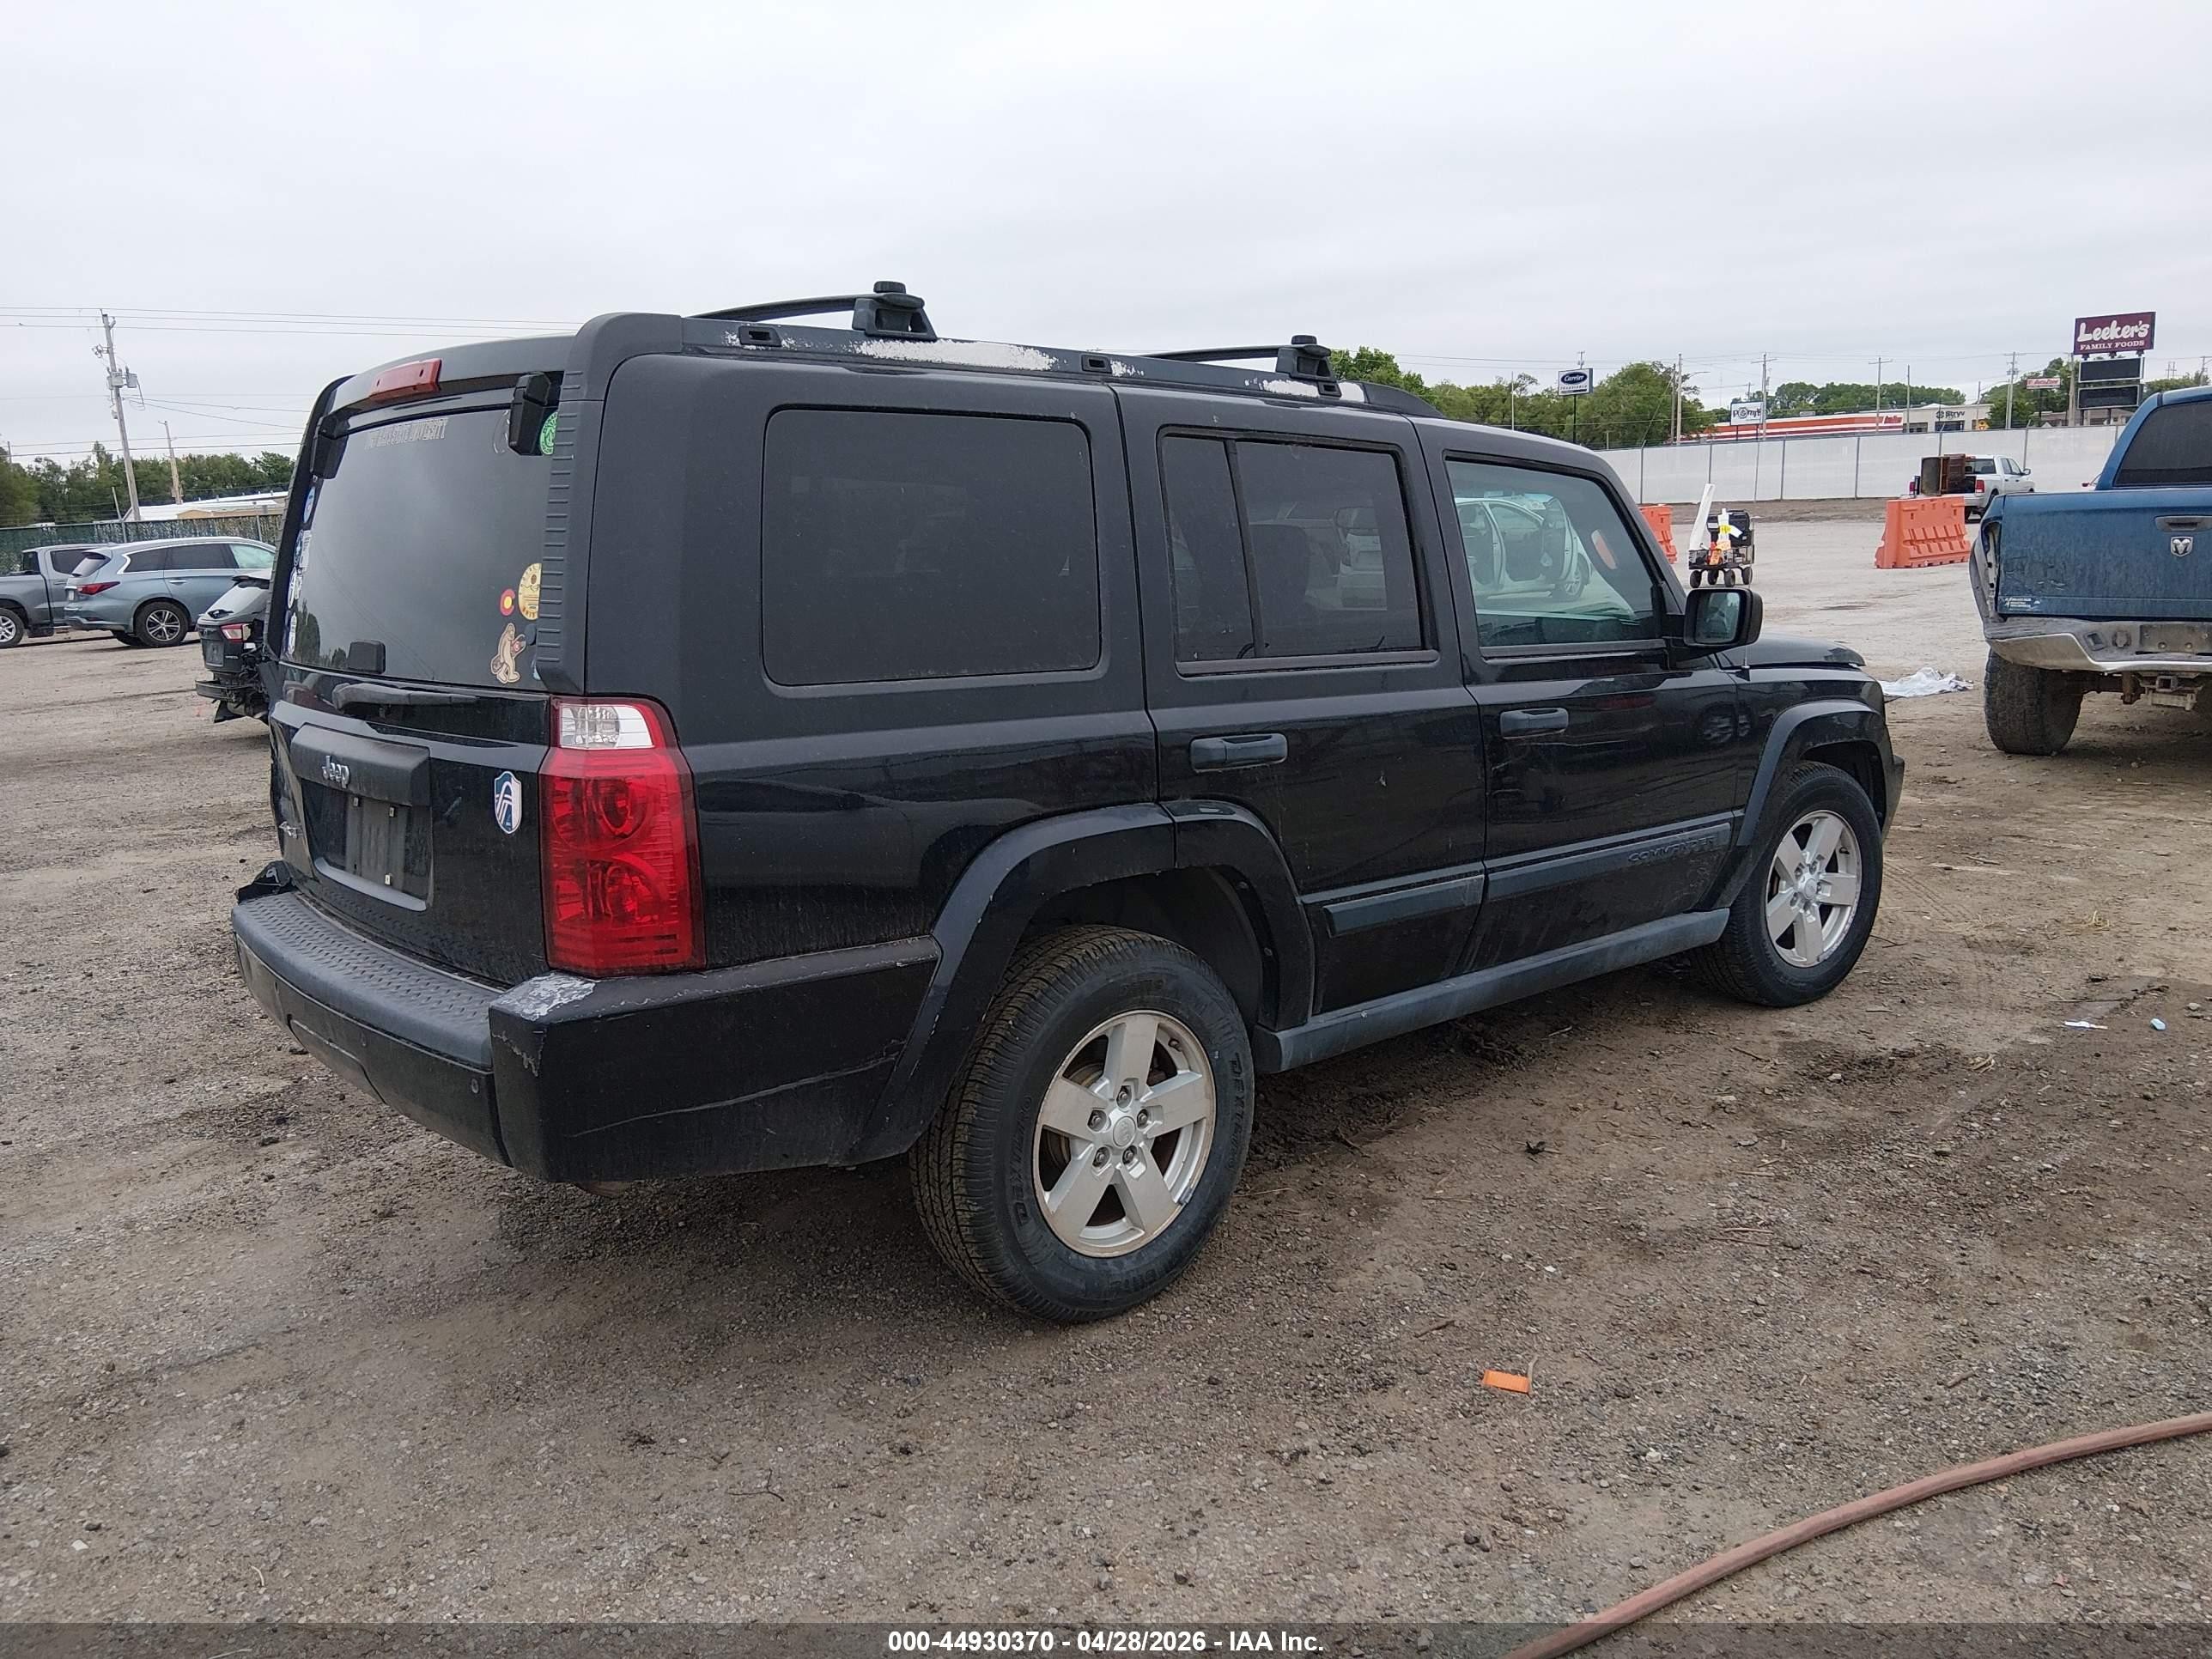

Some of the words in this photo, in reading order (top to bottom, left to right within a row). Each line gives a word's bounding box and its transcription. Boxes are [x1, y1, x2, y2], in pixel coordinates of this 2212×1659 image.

[2077, 320, 2150, 342] Leeker's
[2115, 340, 2144, 349] FOODS
[322, 756, 349, 788] Jeep
